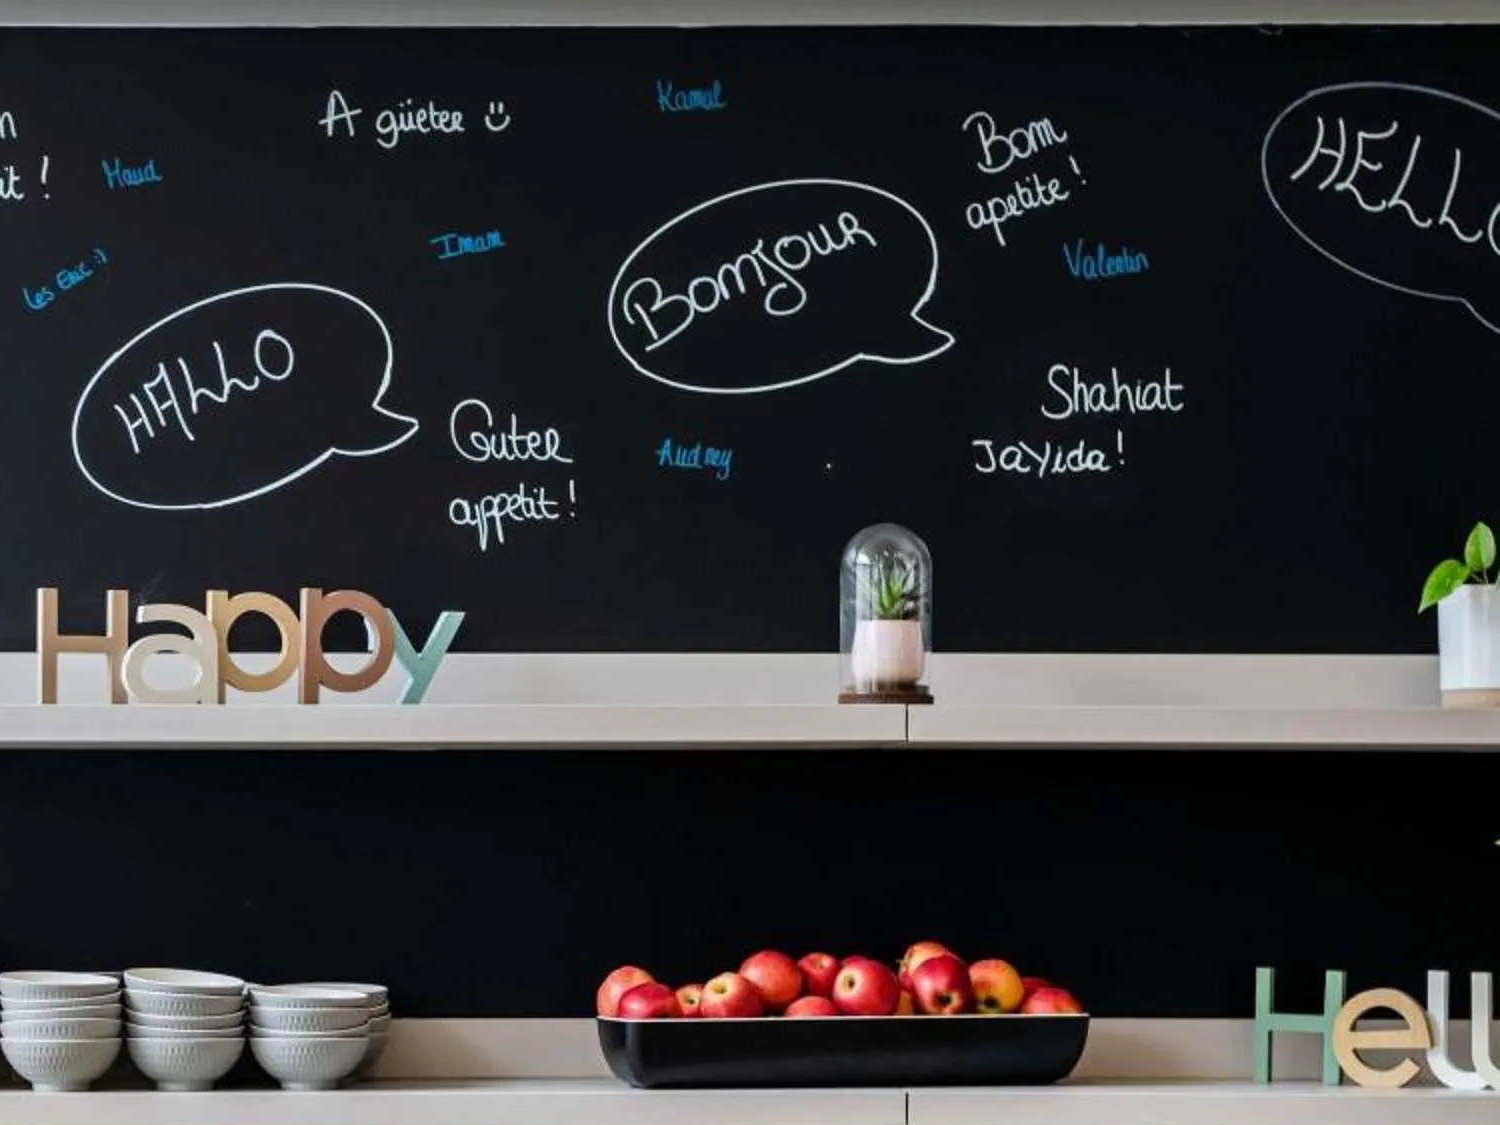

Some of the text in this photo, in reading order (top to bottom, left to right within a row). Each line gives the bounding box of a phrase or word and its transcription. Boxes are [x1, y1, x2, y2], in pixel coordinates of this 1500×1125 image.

[319, 90, 362, 136] A
[1289, 115, 1500, 256] HELL
[113, 328, 295, 454] HALLO
[37, 586, 467, 705] Happy
